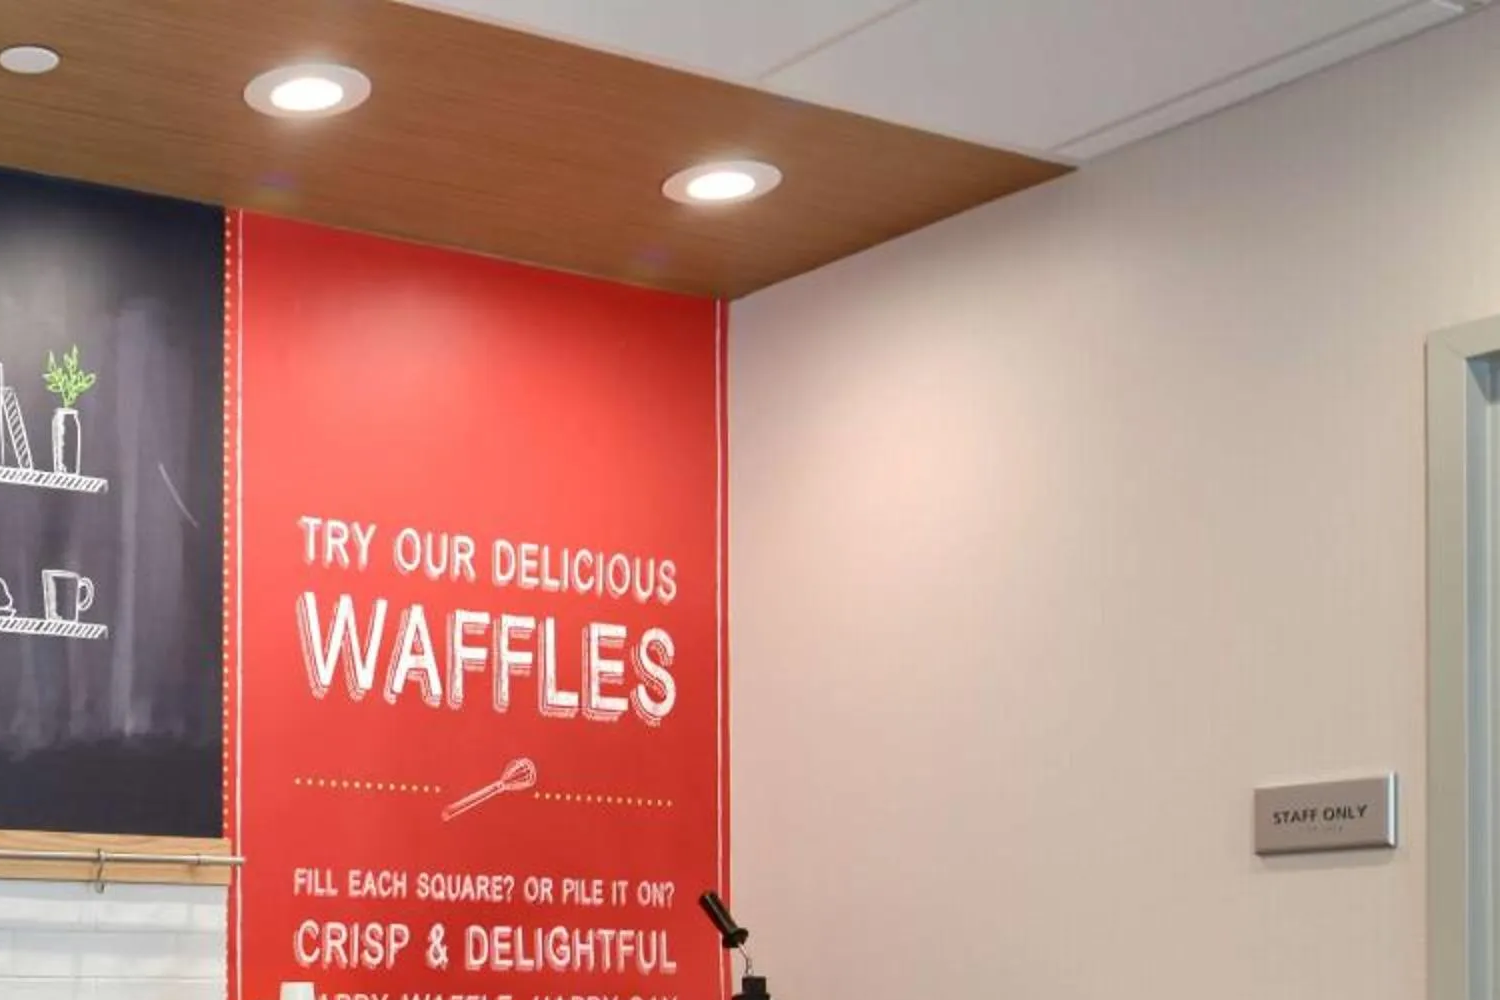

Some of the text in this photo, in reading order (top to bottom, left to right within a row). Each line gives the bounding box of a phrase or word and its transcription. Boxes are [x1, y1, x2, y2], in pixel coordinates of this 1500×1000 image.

[299, 516, 677, 604] TRY OUR DELICIOUS
[296, 591, 677, 727] WAFFLES
[1273, 804, 1368, 825] STAFF ONLY
[294, 868, 675, 909] FILL EACH SQUARE? OR PILE IT ON?
[294, 919, 677, 975] CRISP & DELIGHTFUL
